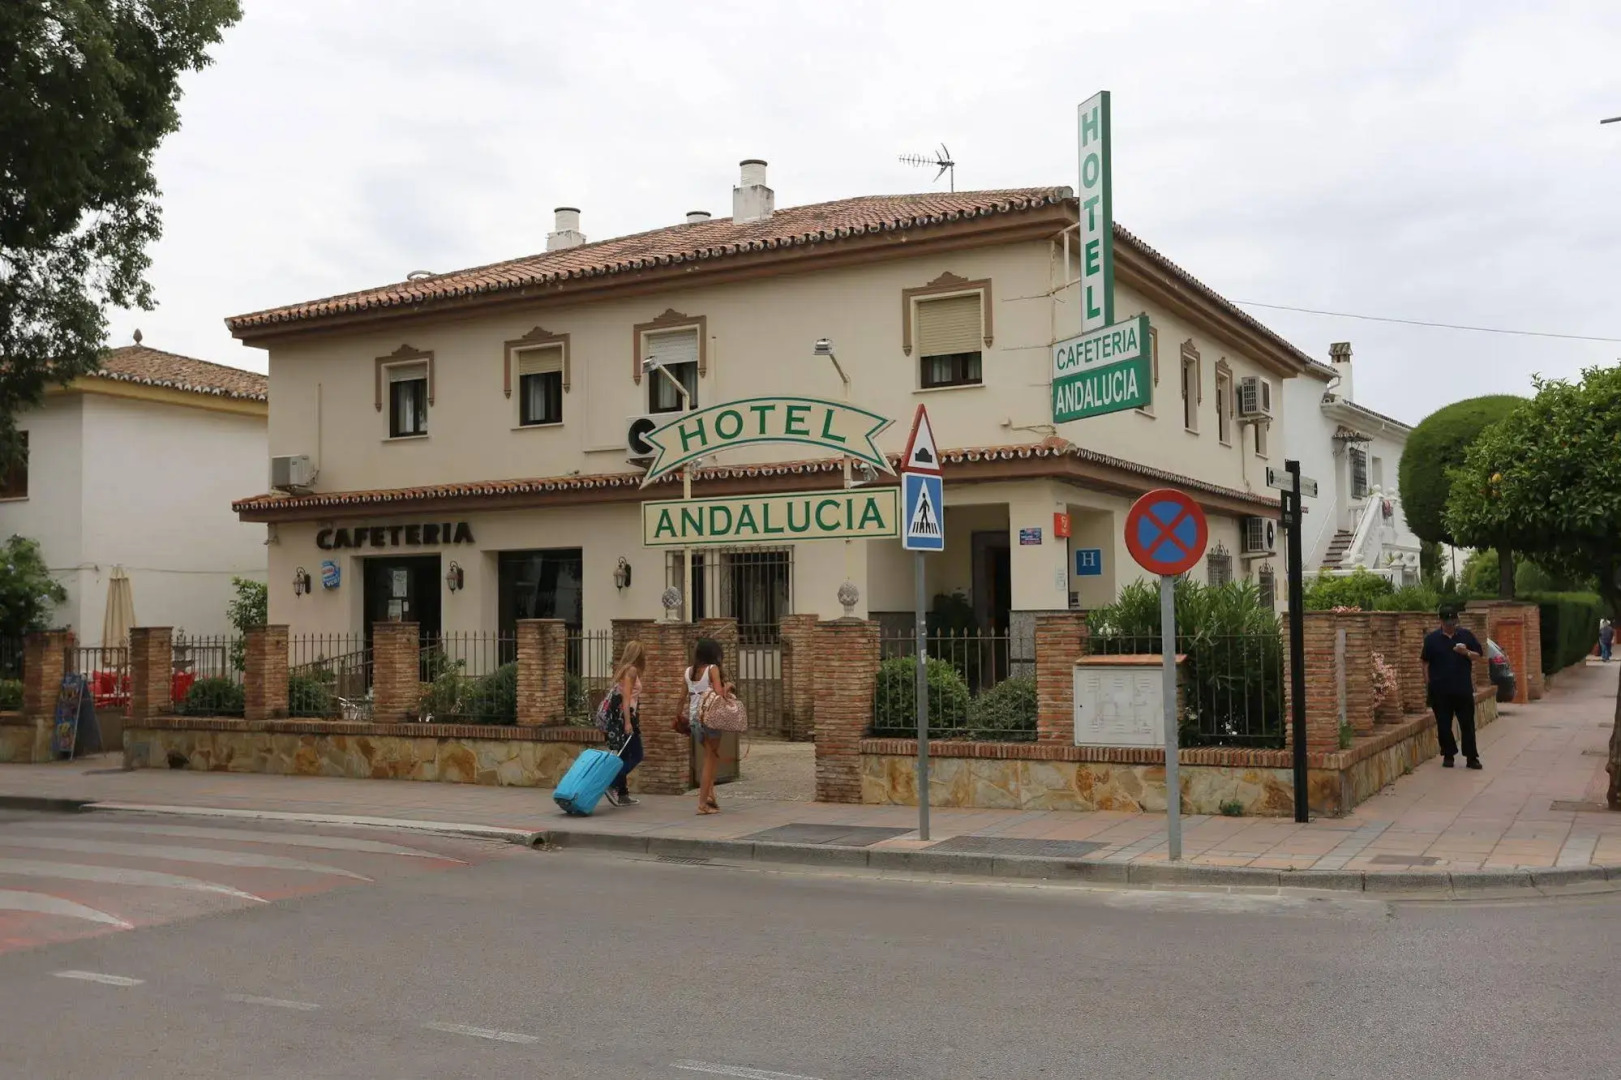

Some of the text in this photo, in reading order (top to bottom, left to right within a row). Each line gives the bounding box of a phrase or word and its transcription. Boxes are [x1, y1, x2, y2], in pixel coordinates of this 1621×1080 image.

[1081, 106, 1101, 320] HOTEL
[1057, 327, 1138, 370] CAFETERIA
[1055, 367, 1139, 415] ANDALUCIA
[677, 404, 847, 453] HOTEL
[316, 521, 475, 550] CAFETERIA
[654, 497, 886, 539] ANDALUCIA
[1081, 551, 1096, 567] H
